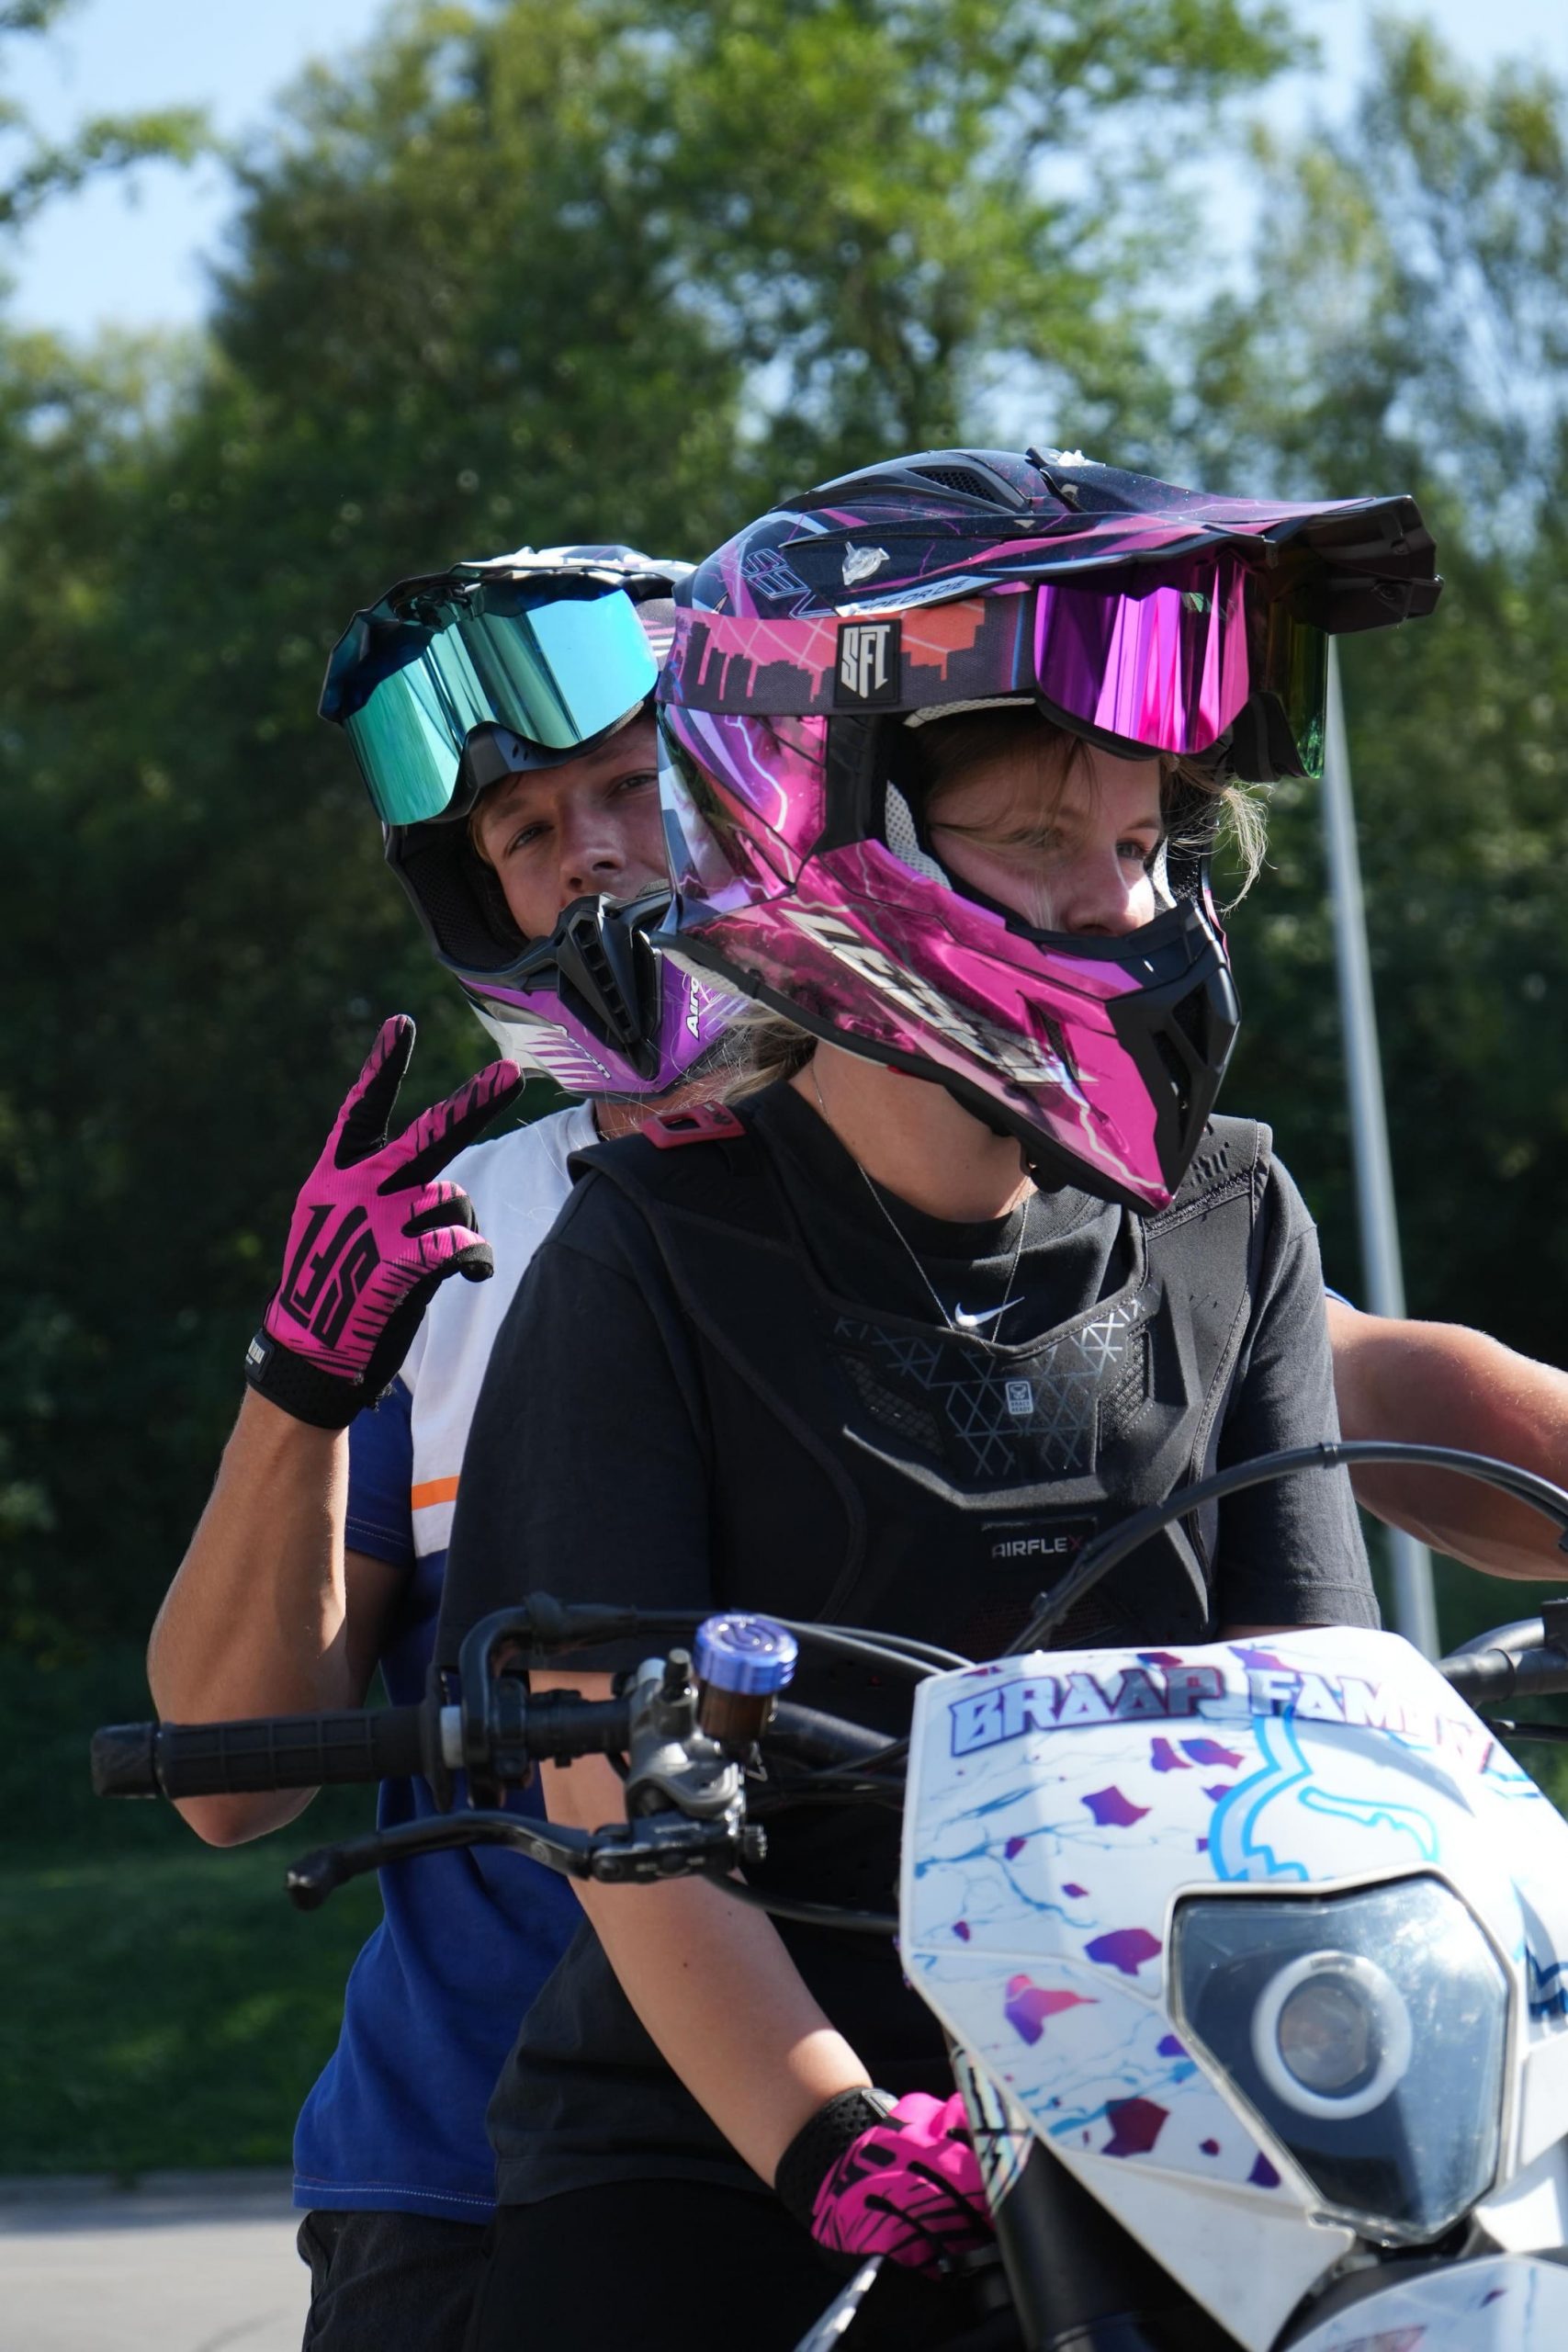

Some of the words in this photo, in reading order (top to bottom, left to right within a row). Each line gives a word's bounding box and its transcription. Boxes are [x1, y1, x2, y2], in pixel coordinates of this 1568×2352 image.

[933, 578, 971, 594] DIE
[840, 625, 890, 699] SFT
[685, 975, 700, 1040] Airo
[992, 1535, 1082, 1558] AIRFLEX
[949, 1667, 1225, 1757] BRAAP
